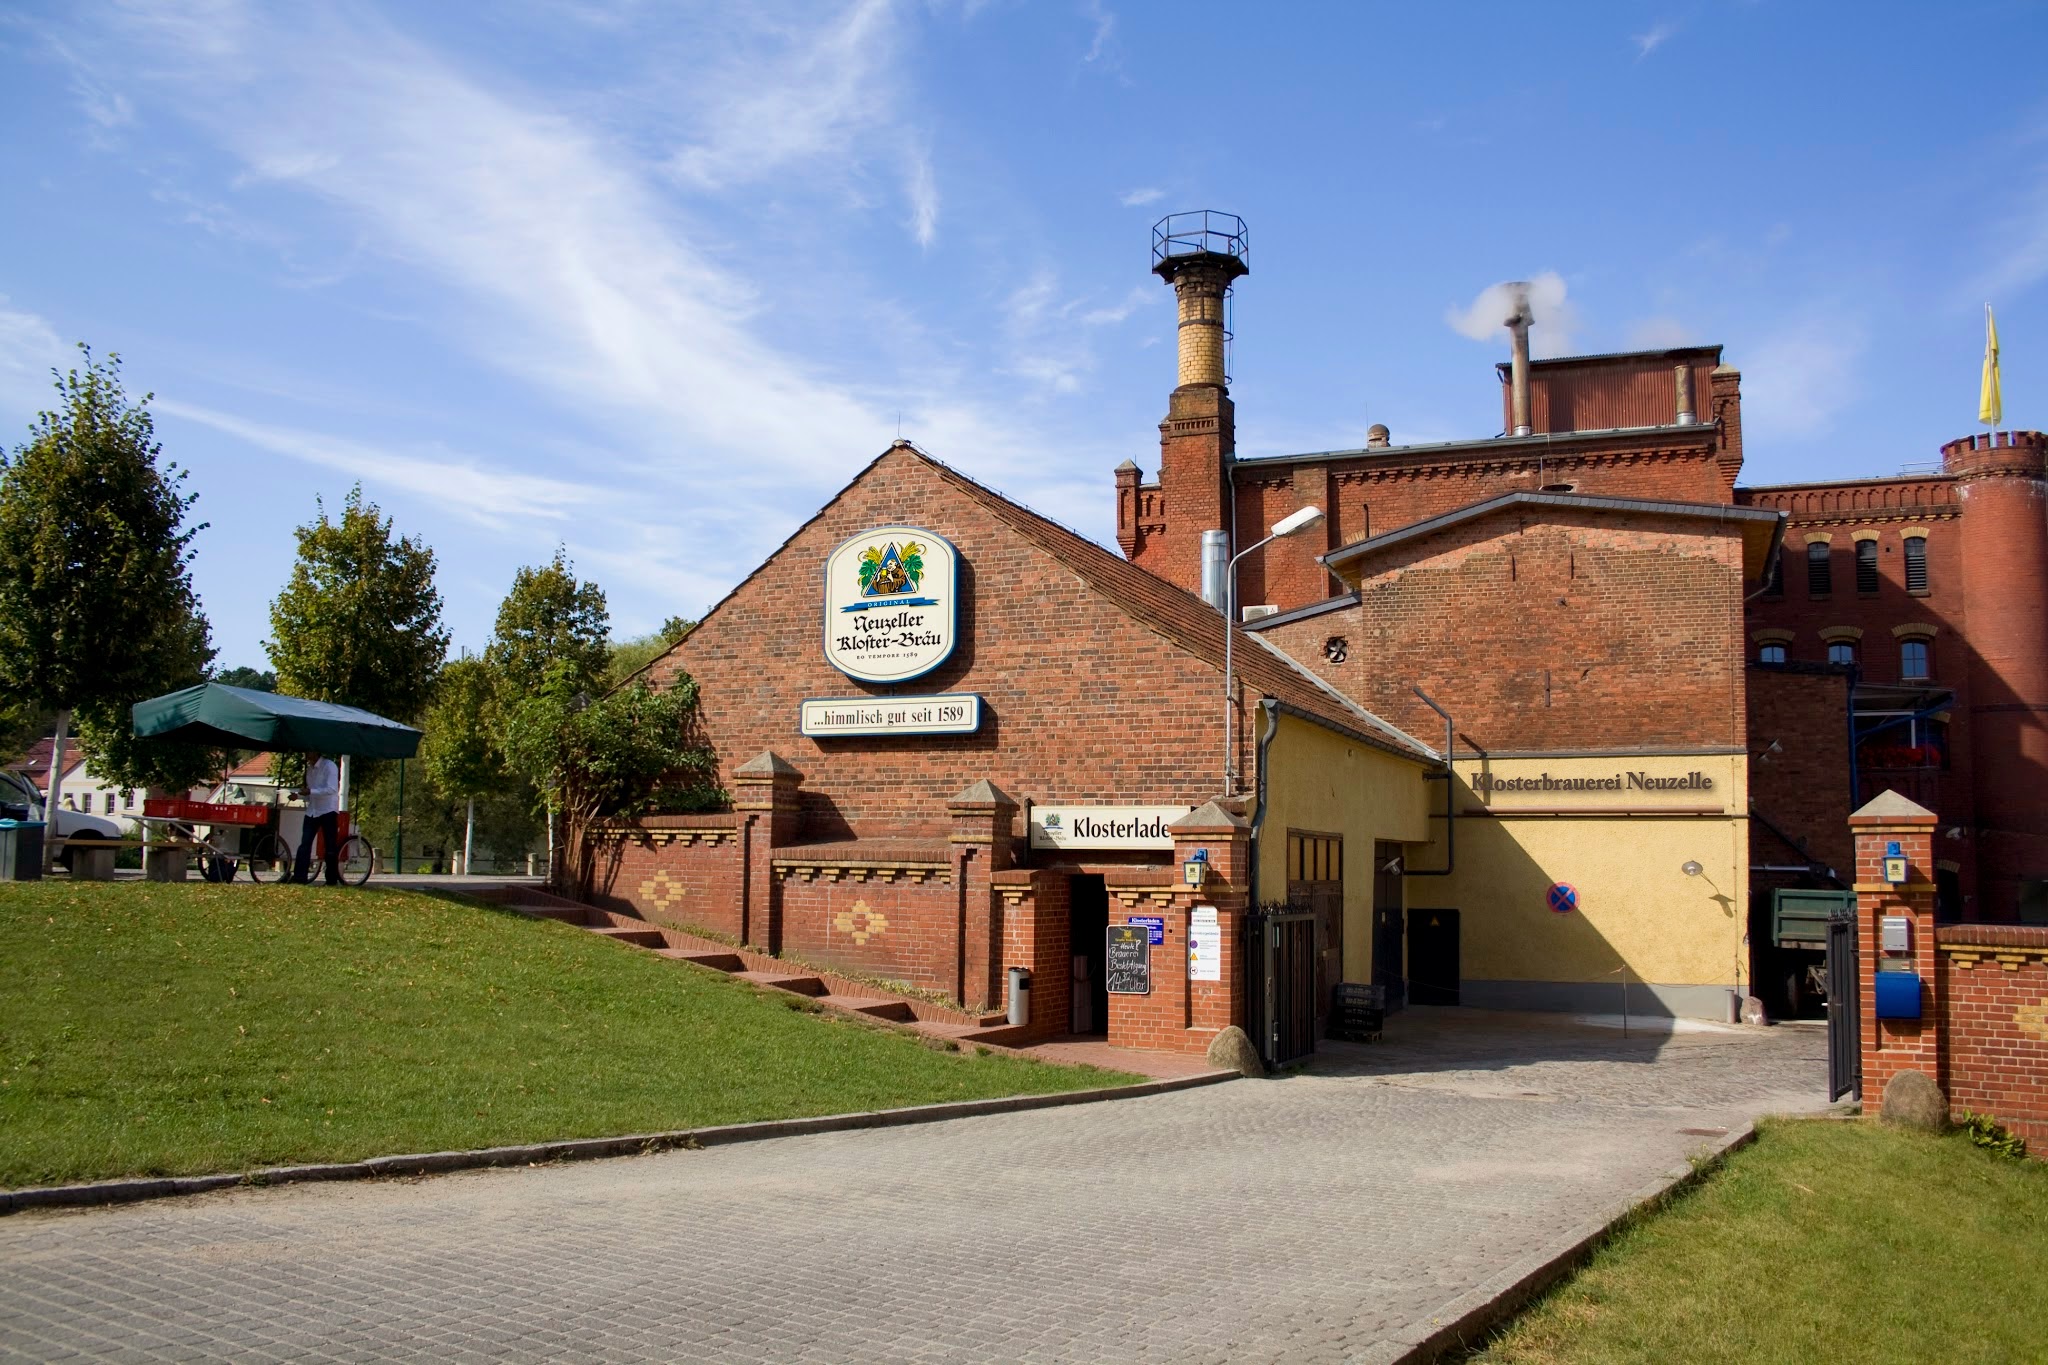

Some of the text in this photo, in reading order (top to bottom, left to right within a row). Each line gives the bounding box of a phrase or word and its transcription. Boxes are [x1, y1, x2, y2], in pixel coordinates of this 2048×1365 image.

[867, 599, 911, 608] ORIGINAL
[853, 611, 924, 635] Neuzeller
[887, 709, 906, 726] gut
[911, 707, 932, 723] seit
[937, 706, 964, 722] 1589
[1471, 771, 1713, 791] Klosterbrauerei Neuzelle
[1074, 816, 1170, 838] Klosterlade
[1130, 977, 1146, 991] Uhr
